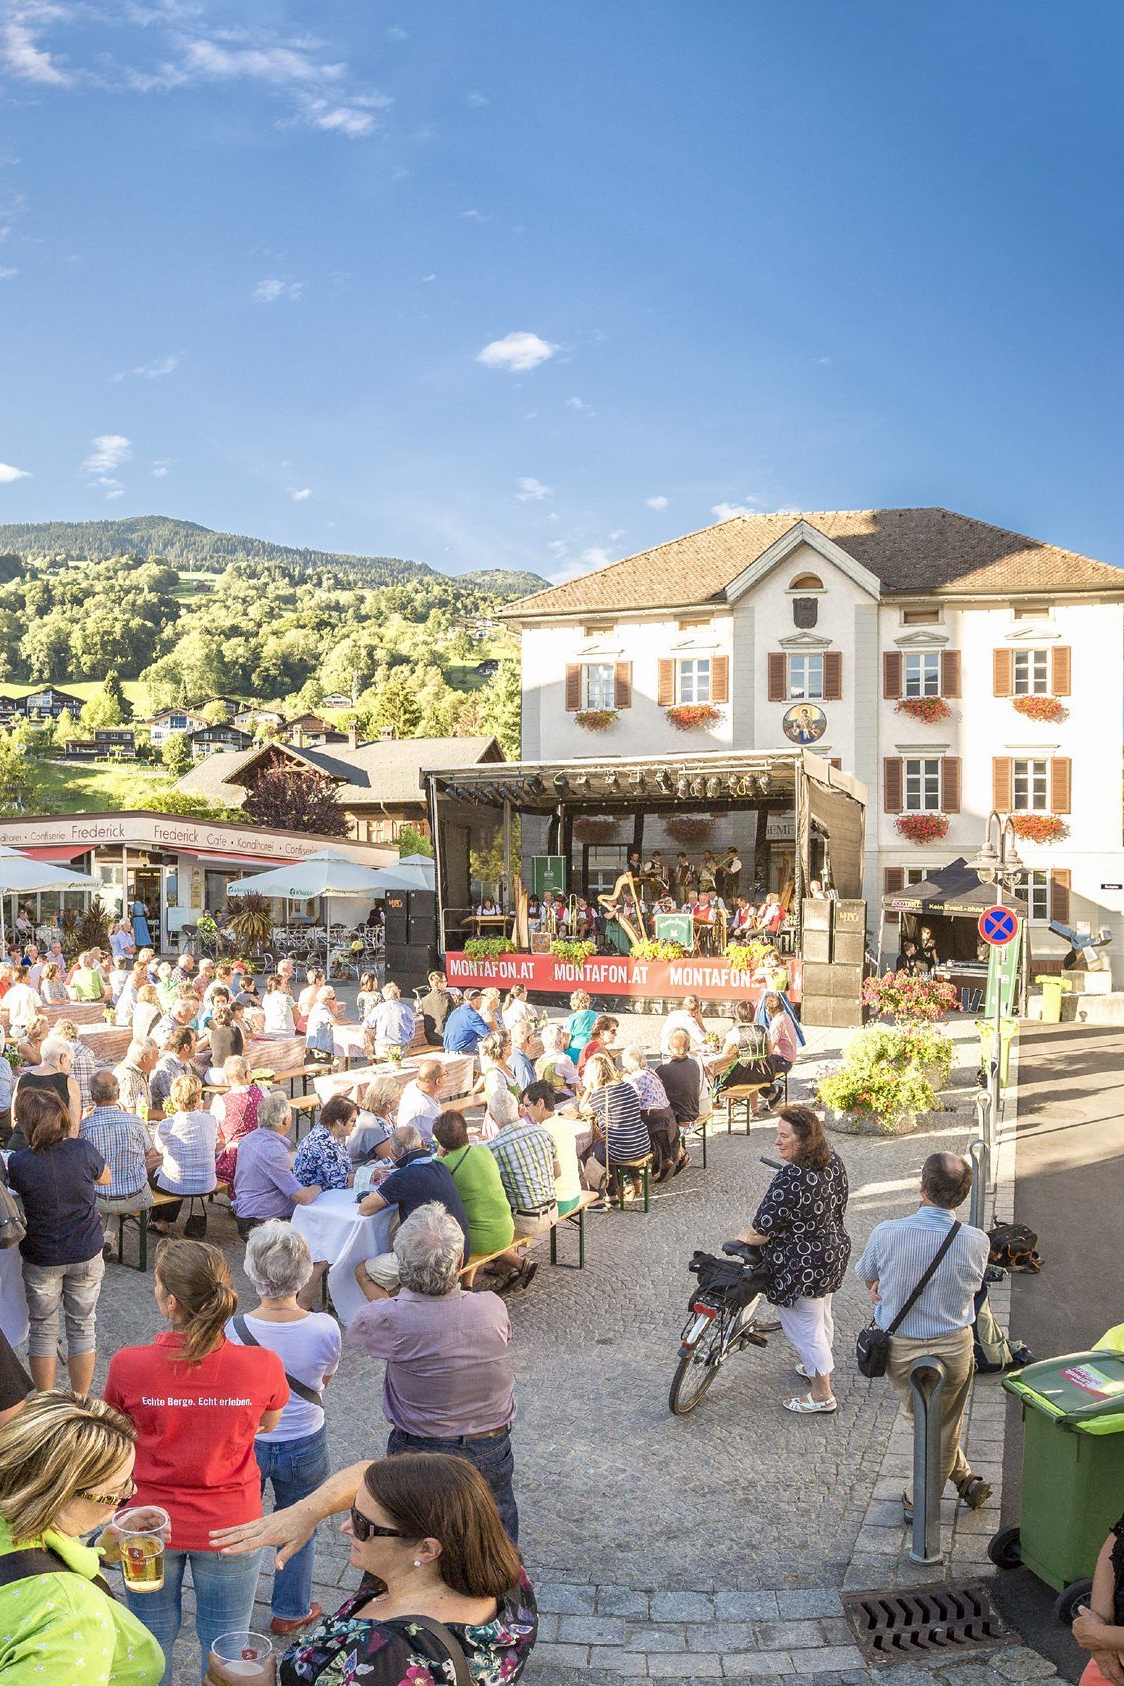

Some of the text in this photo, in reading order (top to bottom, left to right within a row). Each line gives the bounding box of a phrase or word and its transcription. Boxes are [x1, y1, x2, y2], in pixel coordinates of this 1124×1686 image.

[30, 831, 67, 841] Confiserie
[71, 824, 125, 839] Frederick
[154, 825, 199, 843] Frederick
[206, 833, 227, 847] Cafe
[237, 837, 274, 852] Konditorei
[450, 959, 534, 979] MONTAFON.AT
[554, 963, 648, 984] MONTAFON.AT
[142, 1396, 253, 1408] Echte Berge. Echt erleben.
